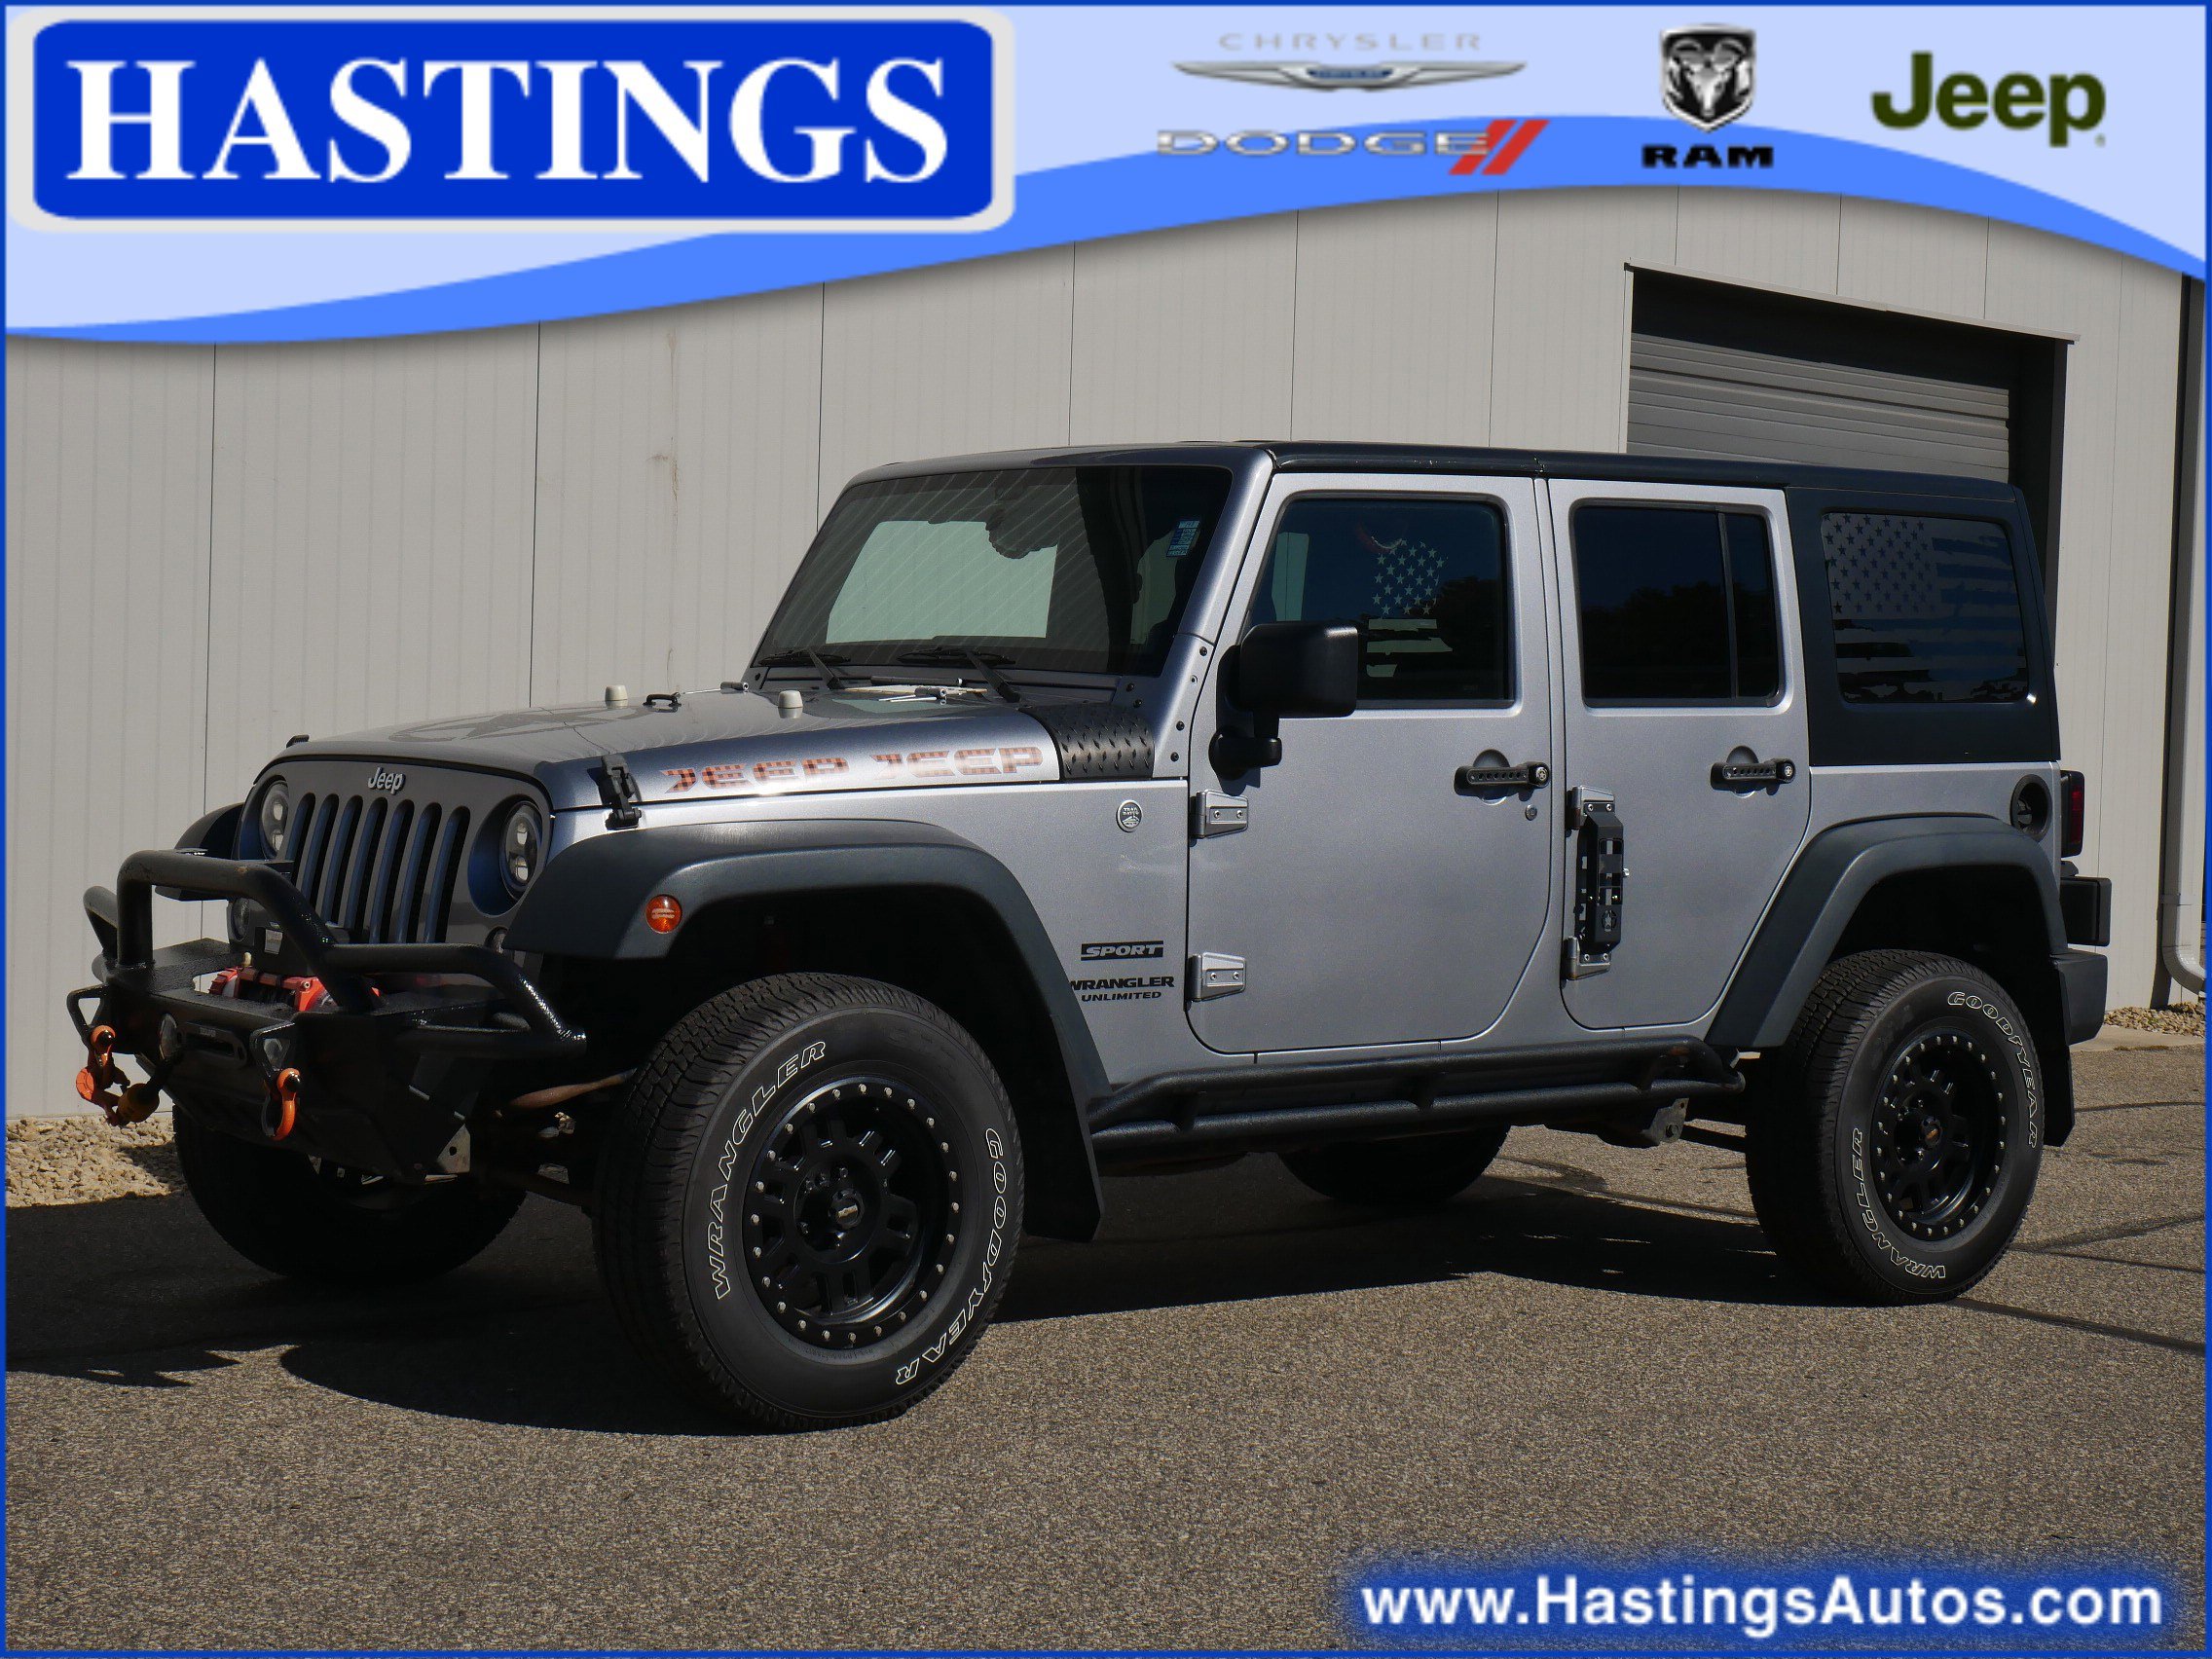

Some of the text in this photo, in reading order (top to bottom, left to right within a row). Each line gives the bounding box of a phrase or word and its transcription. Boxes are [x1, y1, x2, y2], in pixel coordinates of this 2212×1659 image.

[368, 766, 405, 794] Jeep
[1082, 991, 1161, 1002] UNLIMITED
[1083, 943, 1161, 957] SPORT
[1947, 991, 2038, 1149] GOODYEAR
[708, 1041, 826, 1300] WRANGLER
[1852, 1127, 1946, 1279] WRANGLER
[895, 1127, 1007, 1385] GOODYEAR
